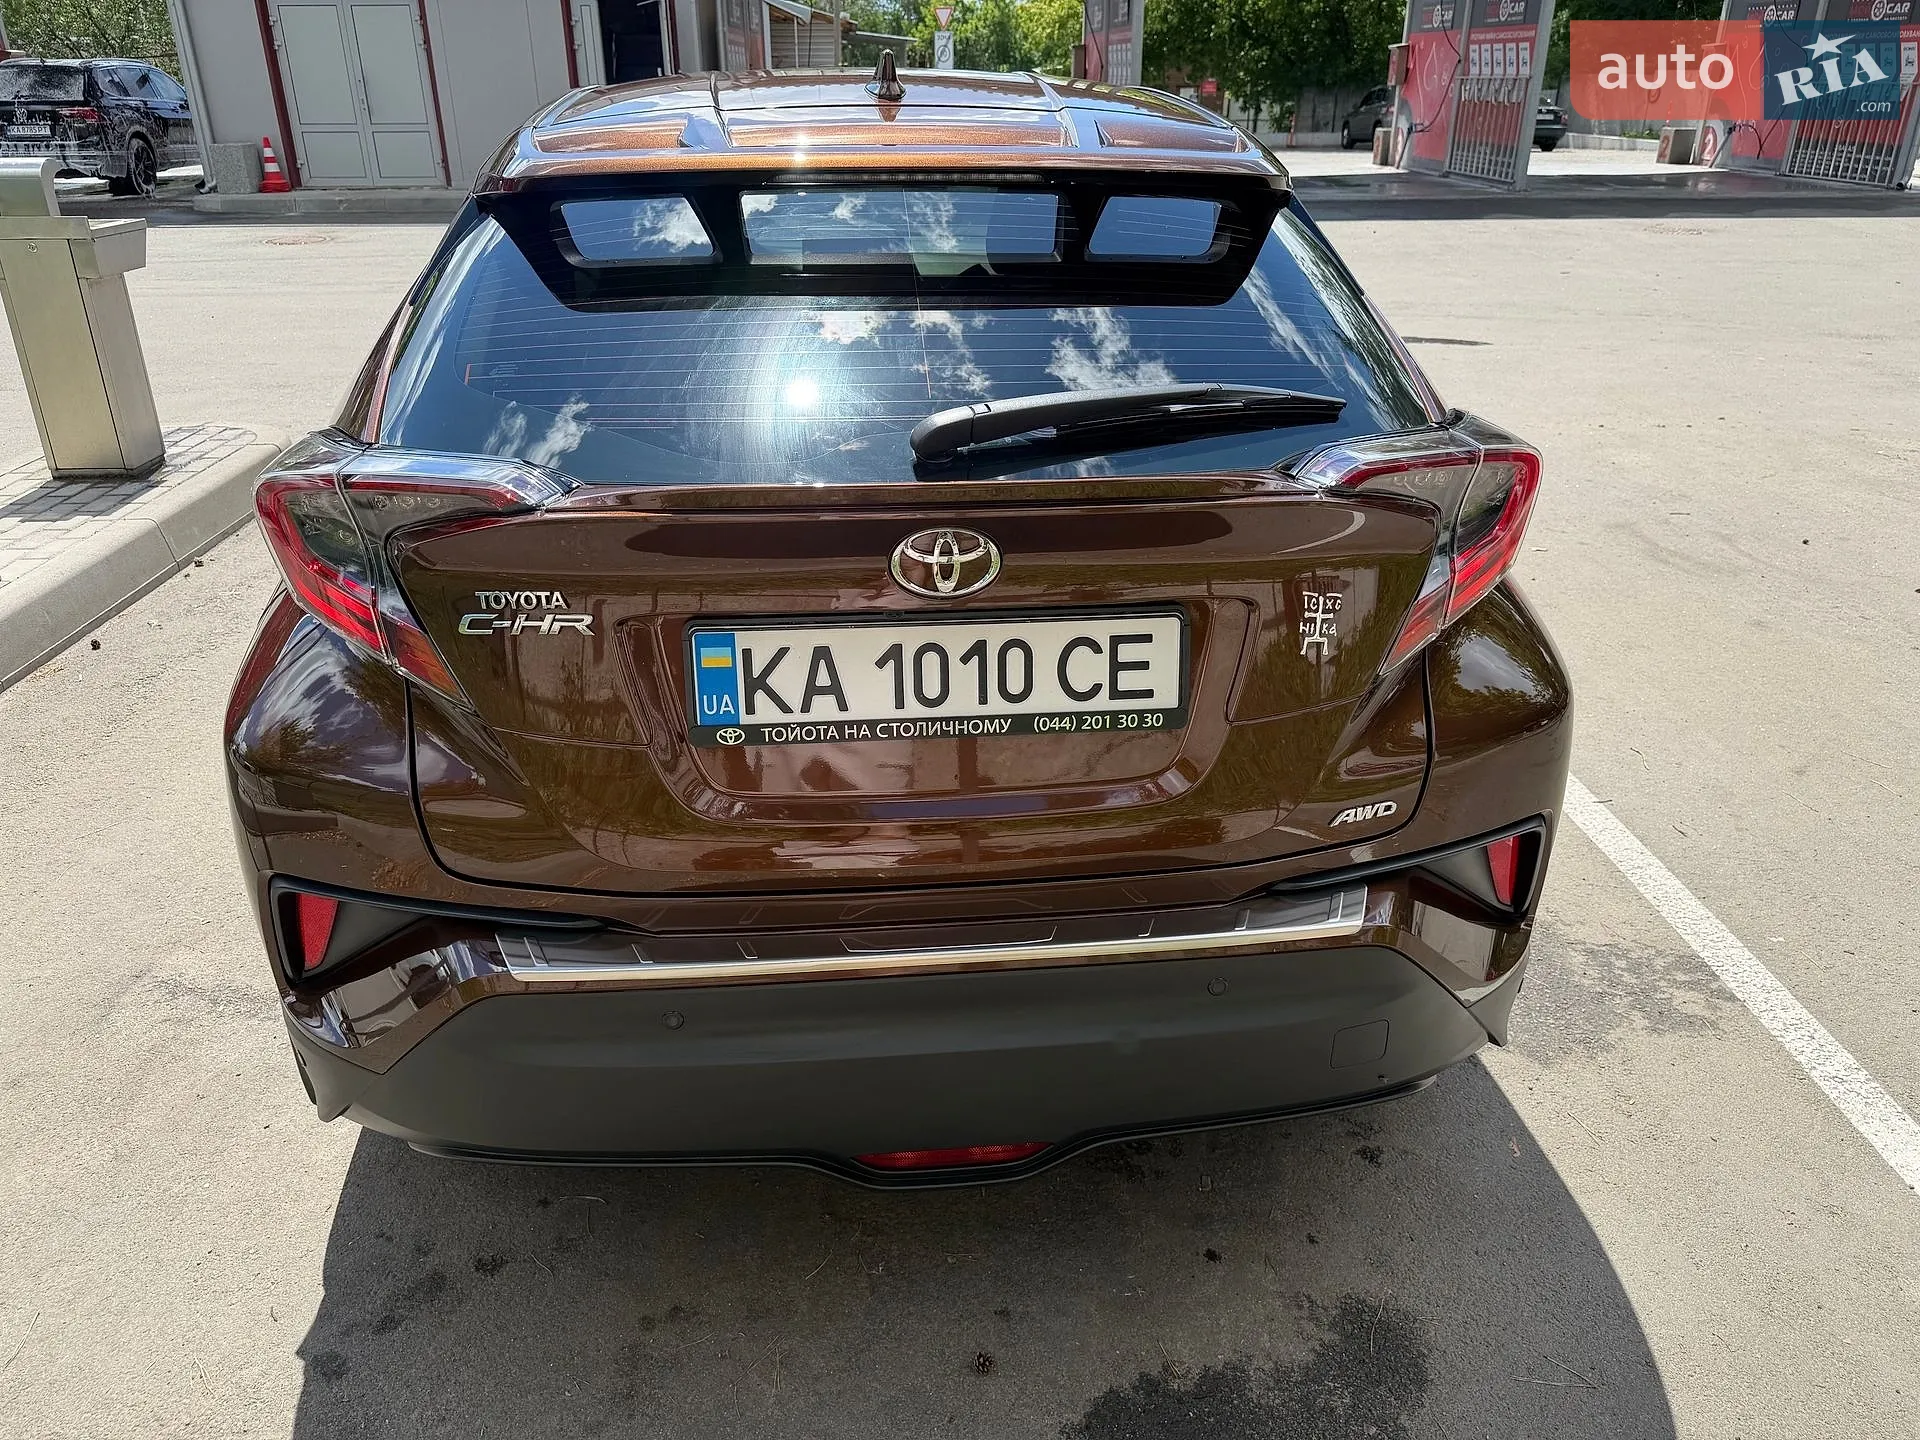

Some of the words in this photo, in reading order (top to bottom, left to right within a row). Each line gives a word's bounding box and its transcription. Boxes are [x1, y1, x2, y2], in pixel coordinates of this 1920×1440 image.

[1510, 1, 1525, 13] CAR
[1886, 2, 1911, 13] CAR
[475, 591, 568, 610] TOYOTA
[458, 613, 595, 636] C-HR
[742, 646, 849, 715] KA
[874, 637, 1034, 710] 1010
[1057, 633, 1155, 702] CE
[703, 694, 725, 715] UA
[761, 723, 839, 743] ТОЙОТА
[844, 722, 871, 740] НА
[876, 717, 1012, 738] СТОЛИЧНОМУ
[1033, 715, 1077, 732] (044)
[1081, 715, 1112, 729] 201
[1117, 713, 1139, 728] 30
[1142, 713, 1164, 727] 30
[1328, 800, 1398, 828] AWD
